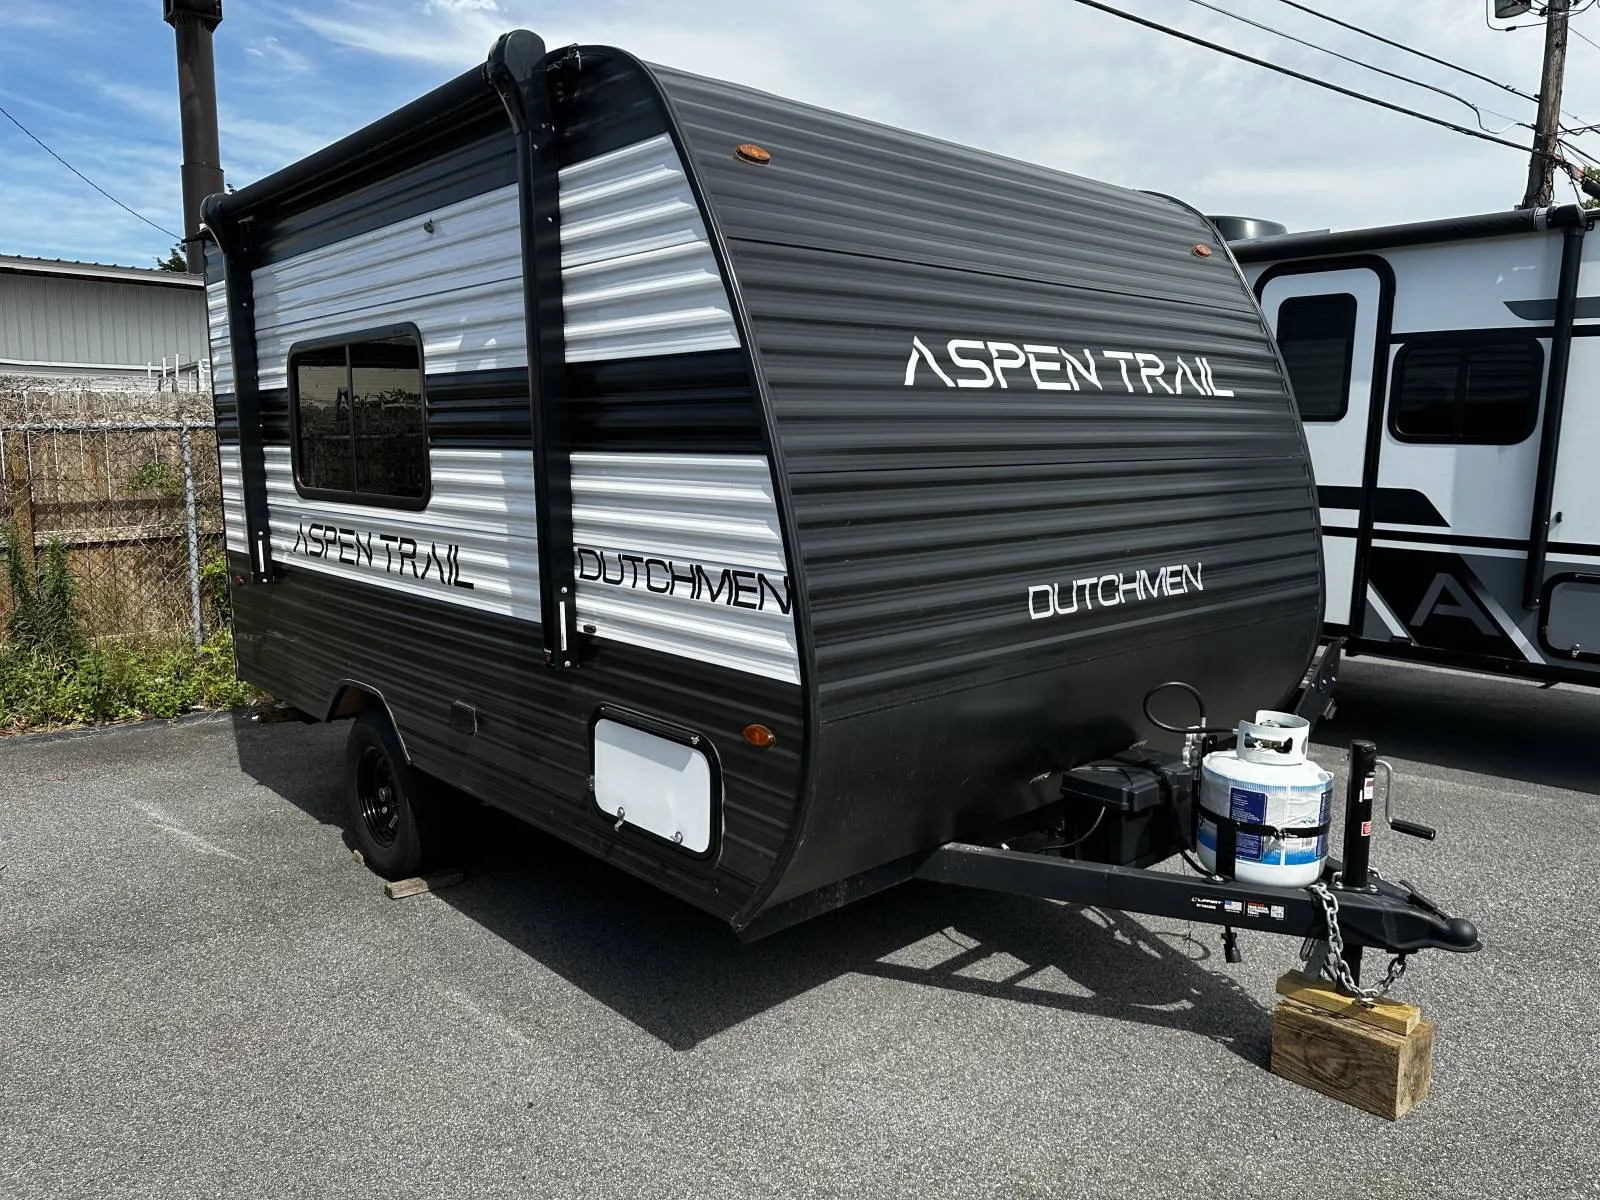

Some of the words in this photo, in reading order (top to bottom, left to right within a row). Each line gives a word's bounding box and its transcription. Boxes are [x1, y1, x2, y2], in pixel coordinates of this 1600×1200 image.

[903, 335, 1103, 391] ASPEN
[1102, 350, 1235, 397] TRAIL
[293, 521, 373, 568] ASPEN
[379, 533, 475, 590] TRAIL
[577, 547, 793, 615] DUTCHMEN
[1028, 562, 1204, 620] DUTCHMEN
